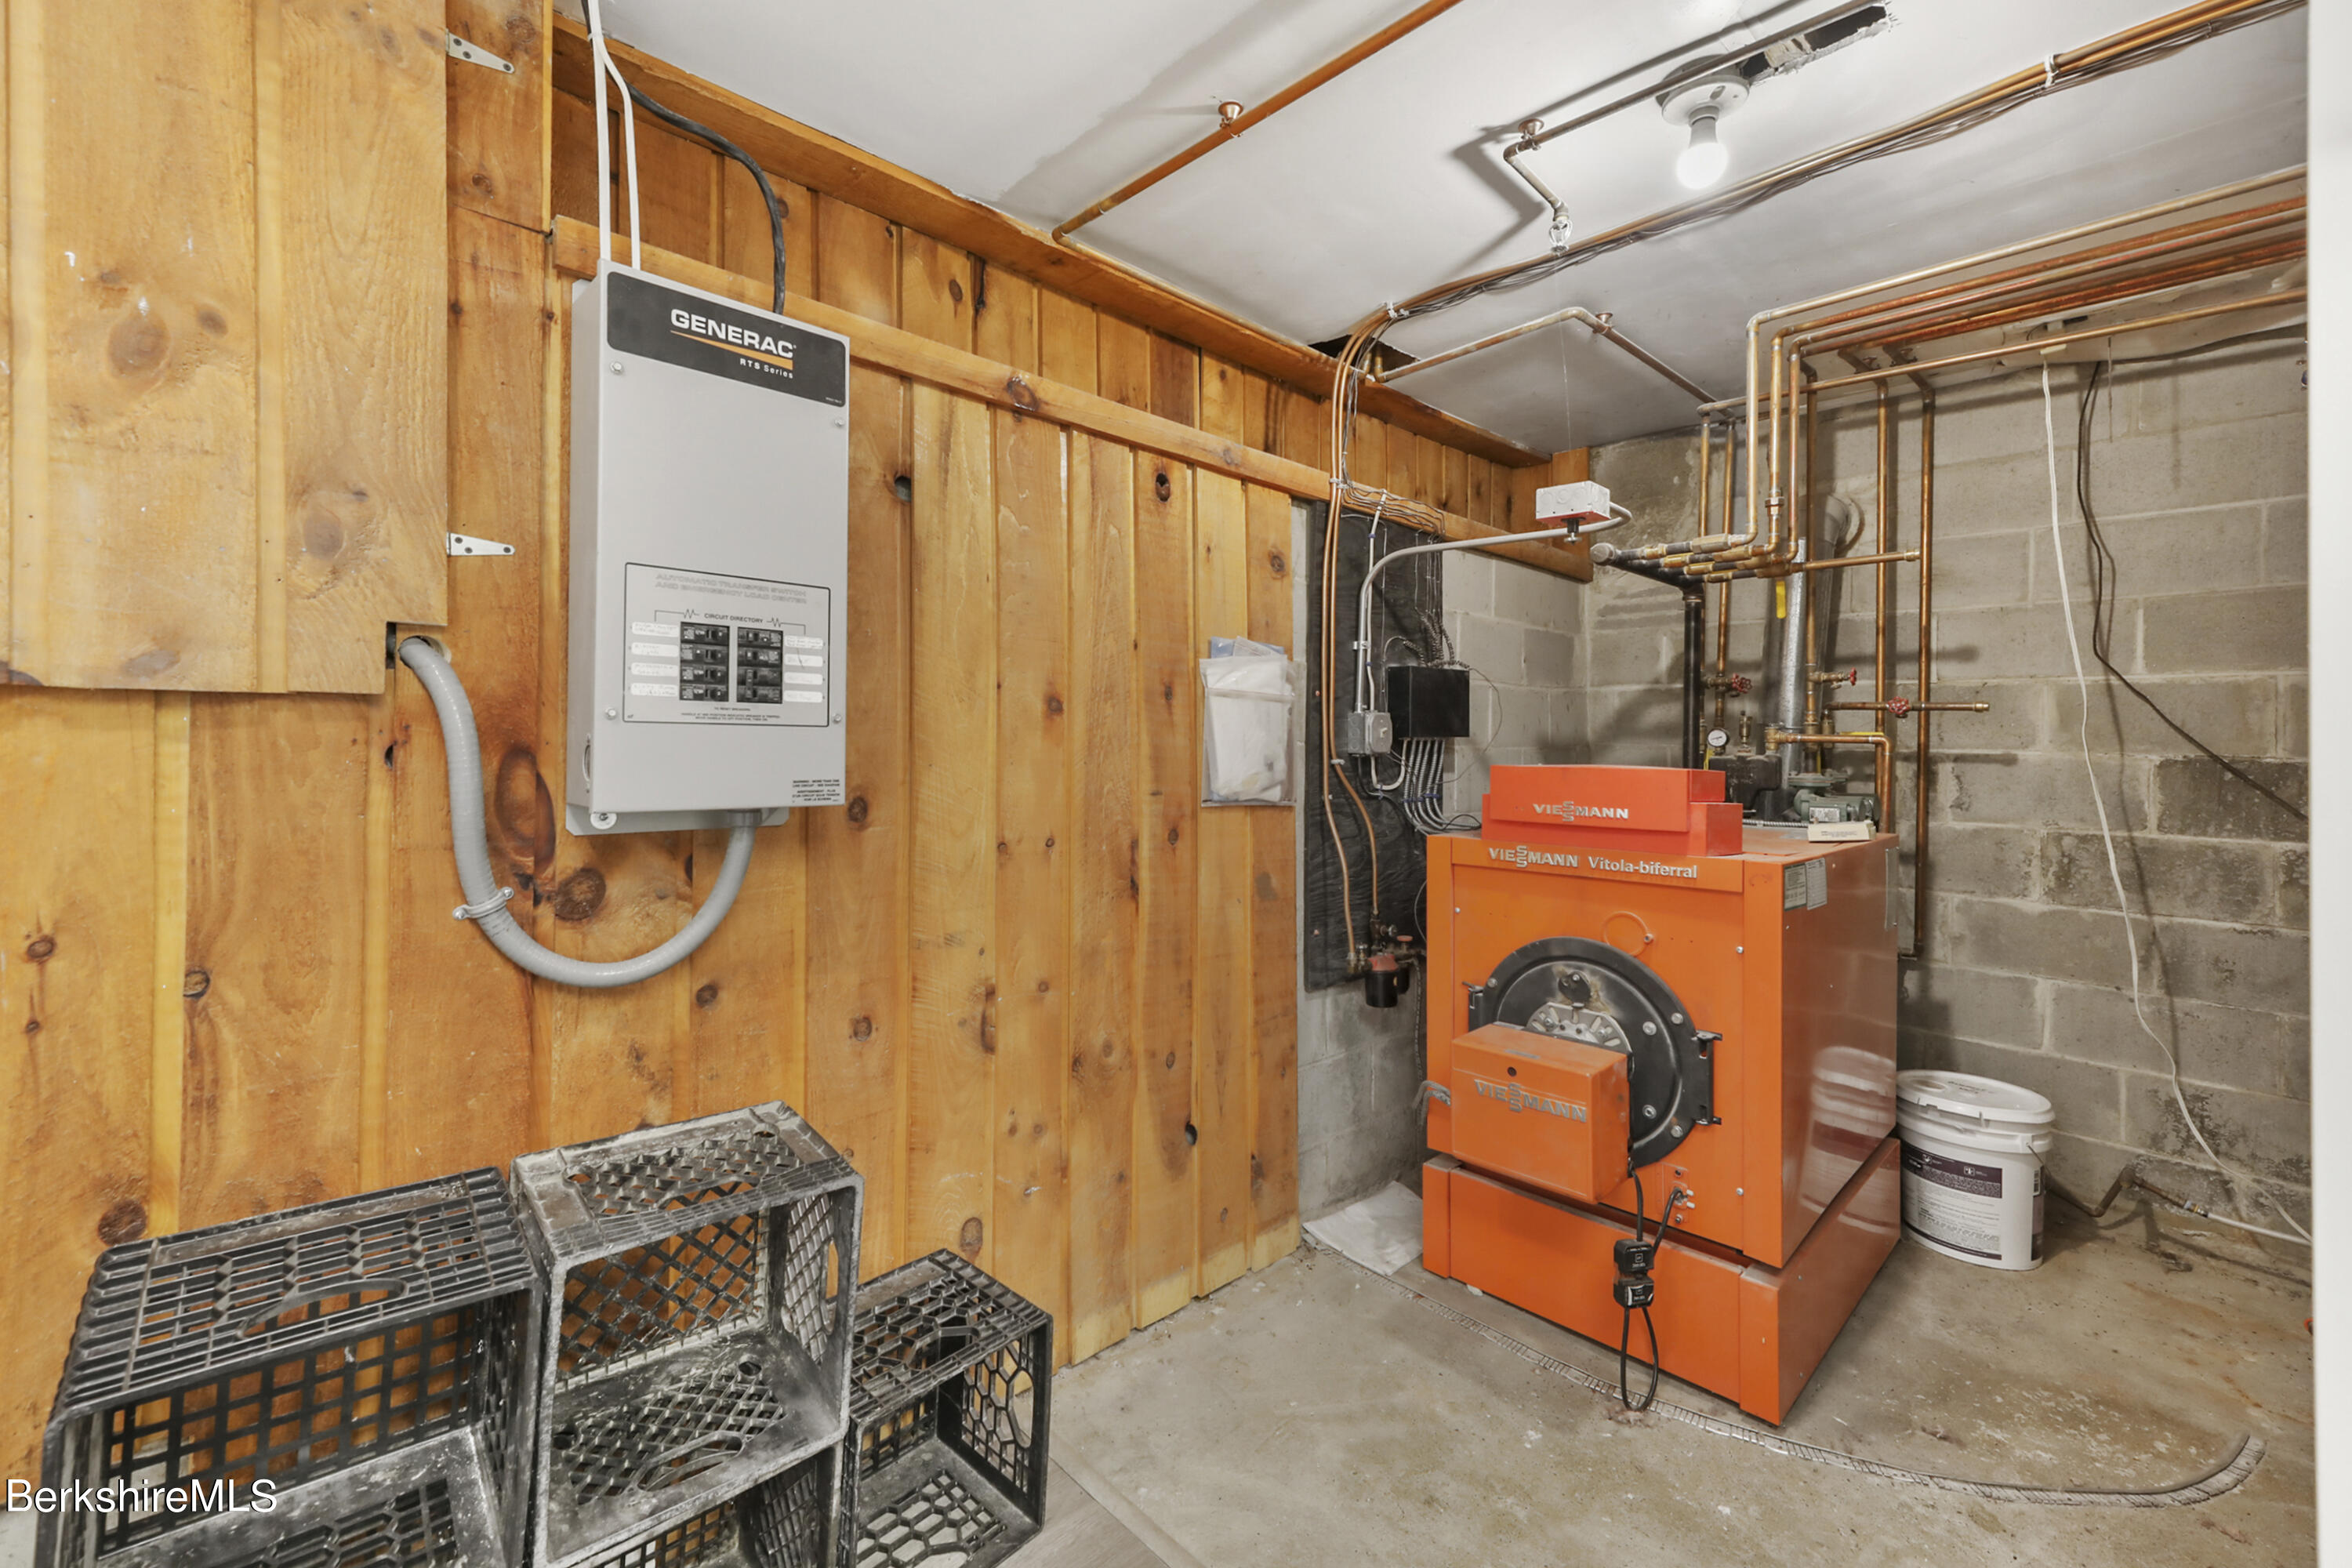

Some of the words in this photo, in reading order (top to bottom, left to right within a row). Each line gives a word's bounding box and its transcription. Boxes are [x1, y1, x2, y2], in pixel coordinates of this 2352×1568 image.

[670, 309, 793, 358] GENERAC
[740, 358, 760, 370] RTS
[764, 365, 793, 379] Series
[704, 613, 729, 622] CIRCUIT
[729, 615, 764, 624] DIRECTORY
[1533, 800, 1628, 822] VIESSMANN
[1489, 845, 1579, 868] VIESSMANN
[1588, 856, 1697, 879] Vitola-biferral
[1474, 1080, 1587, 1123] VIESSMANN
